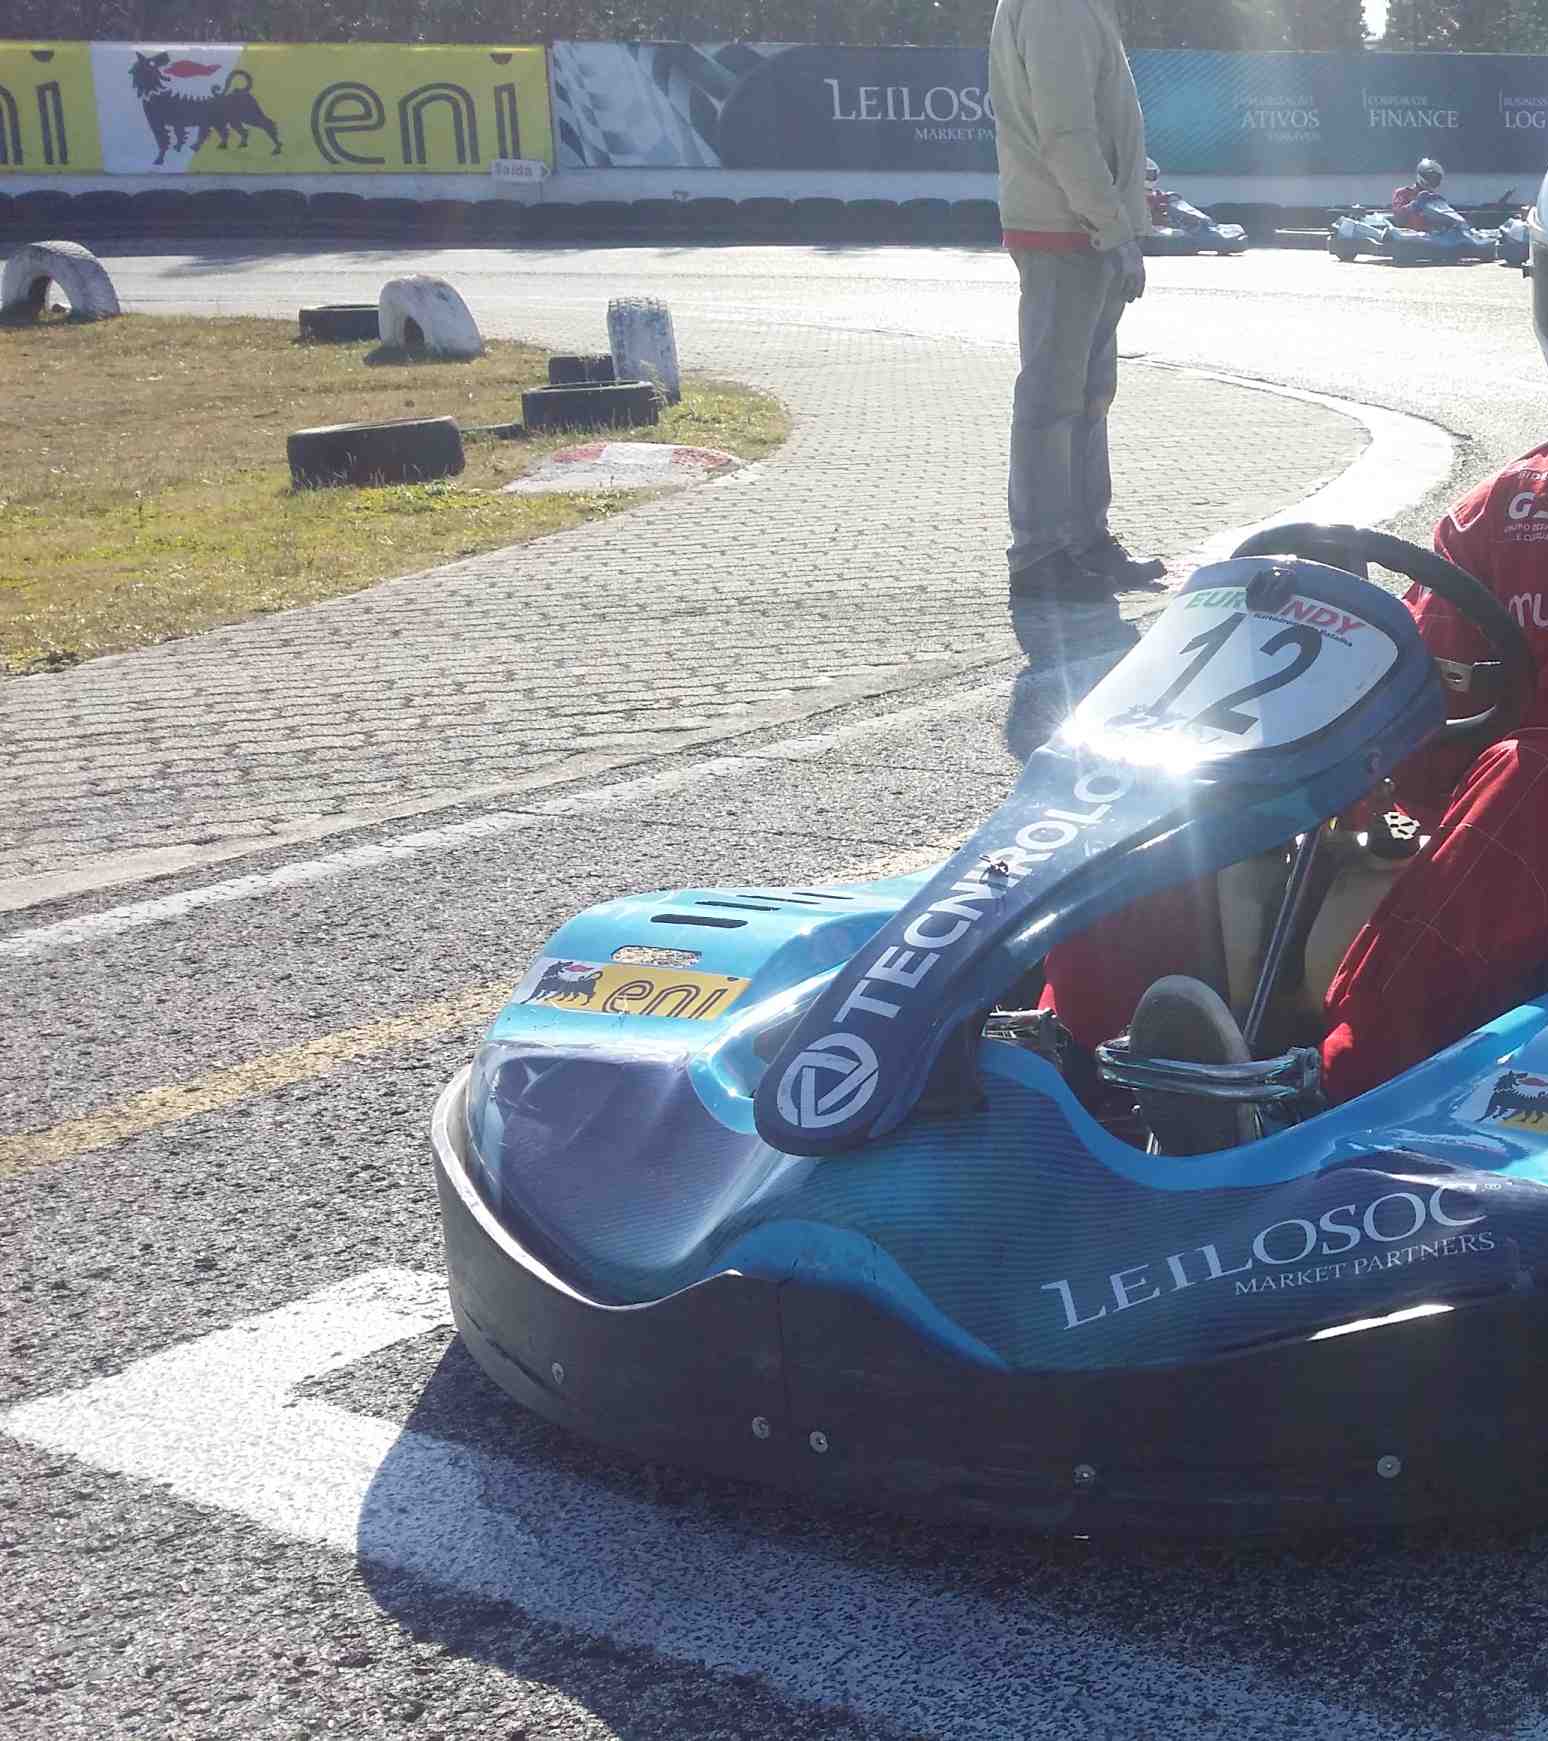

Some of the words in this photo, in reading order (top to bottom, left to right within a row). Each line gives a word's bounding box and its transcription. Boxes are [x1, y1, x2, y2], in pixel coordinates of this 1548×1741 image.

[311, 52, 521, 166] eni
[914, 127, 974, 141] MARKET
[1240, 109, 1321, 129] ATIVOS
[1369, 109, 1459, 128] FINANCE
[1146, 611, 1323, 736] 12
[833, 767, 1137, 1024] TECNIROLO
[601, 976, 738, 1020] eni
[1041, 1184, 1488, 1331] LEILOSOC
[1233, 1262, 1348, 1297] MARKET
[1353, 1230, 1497, 1276] PARTNERS
